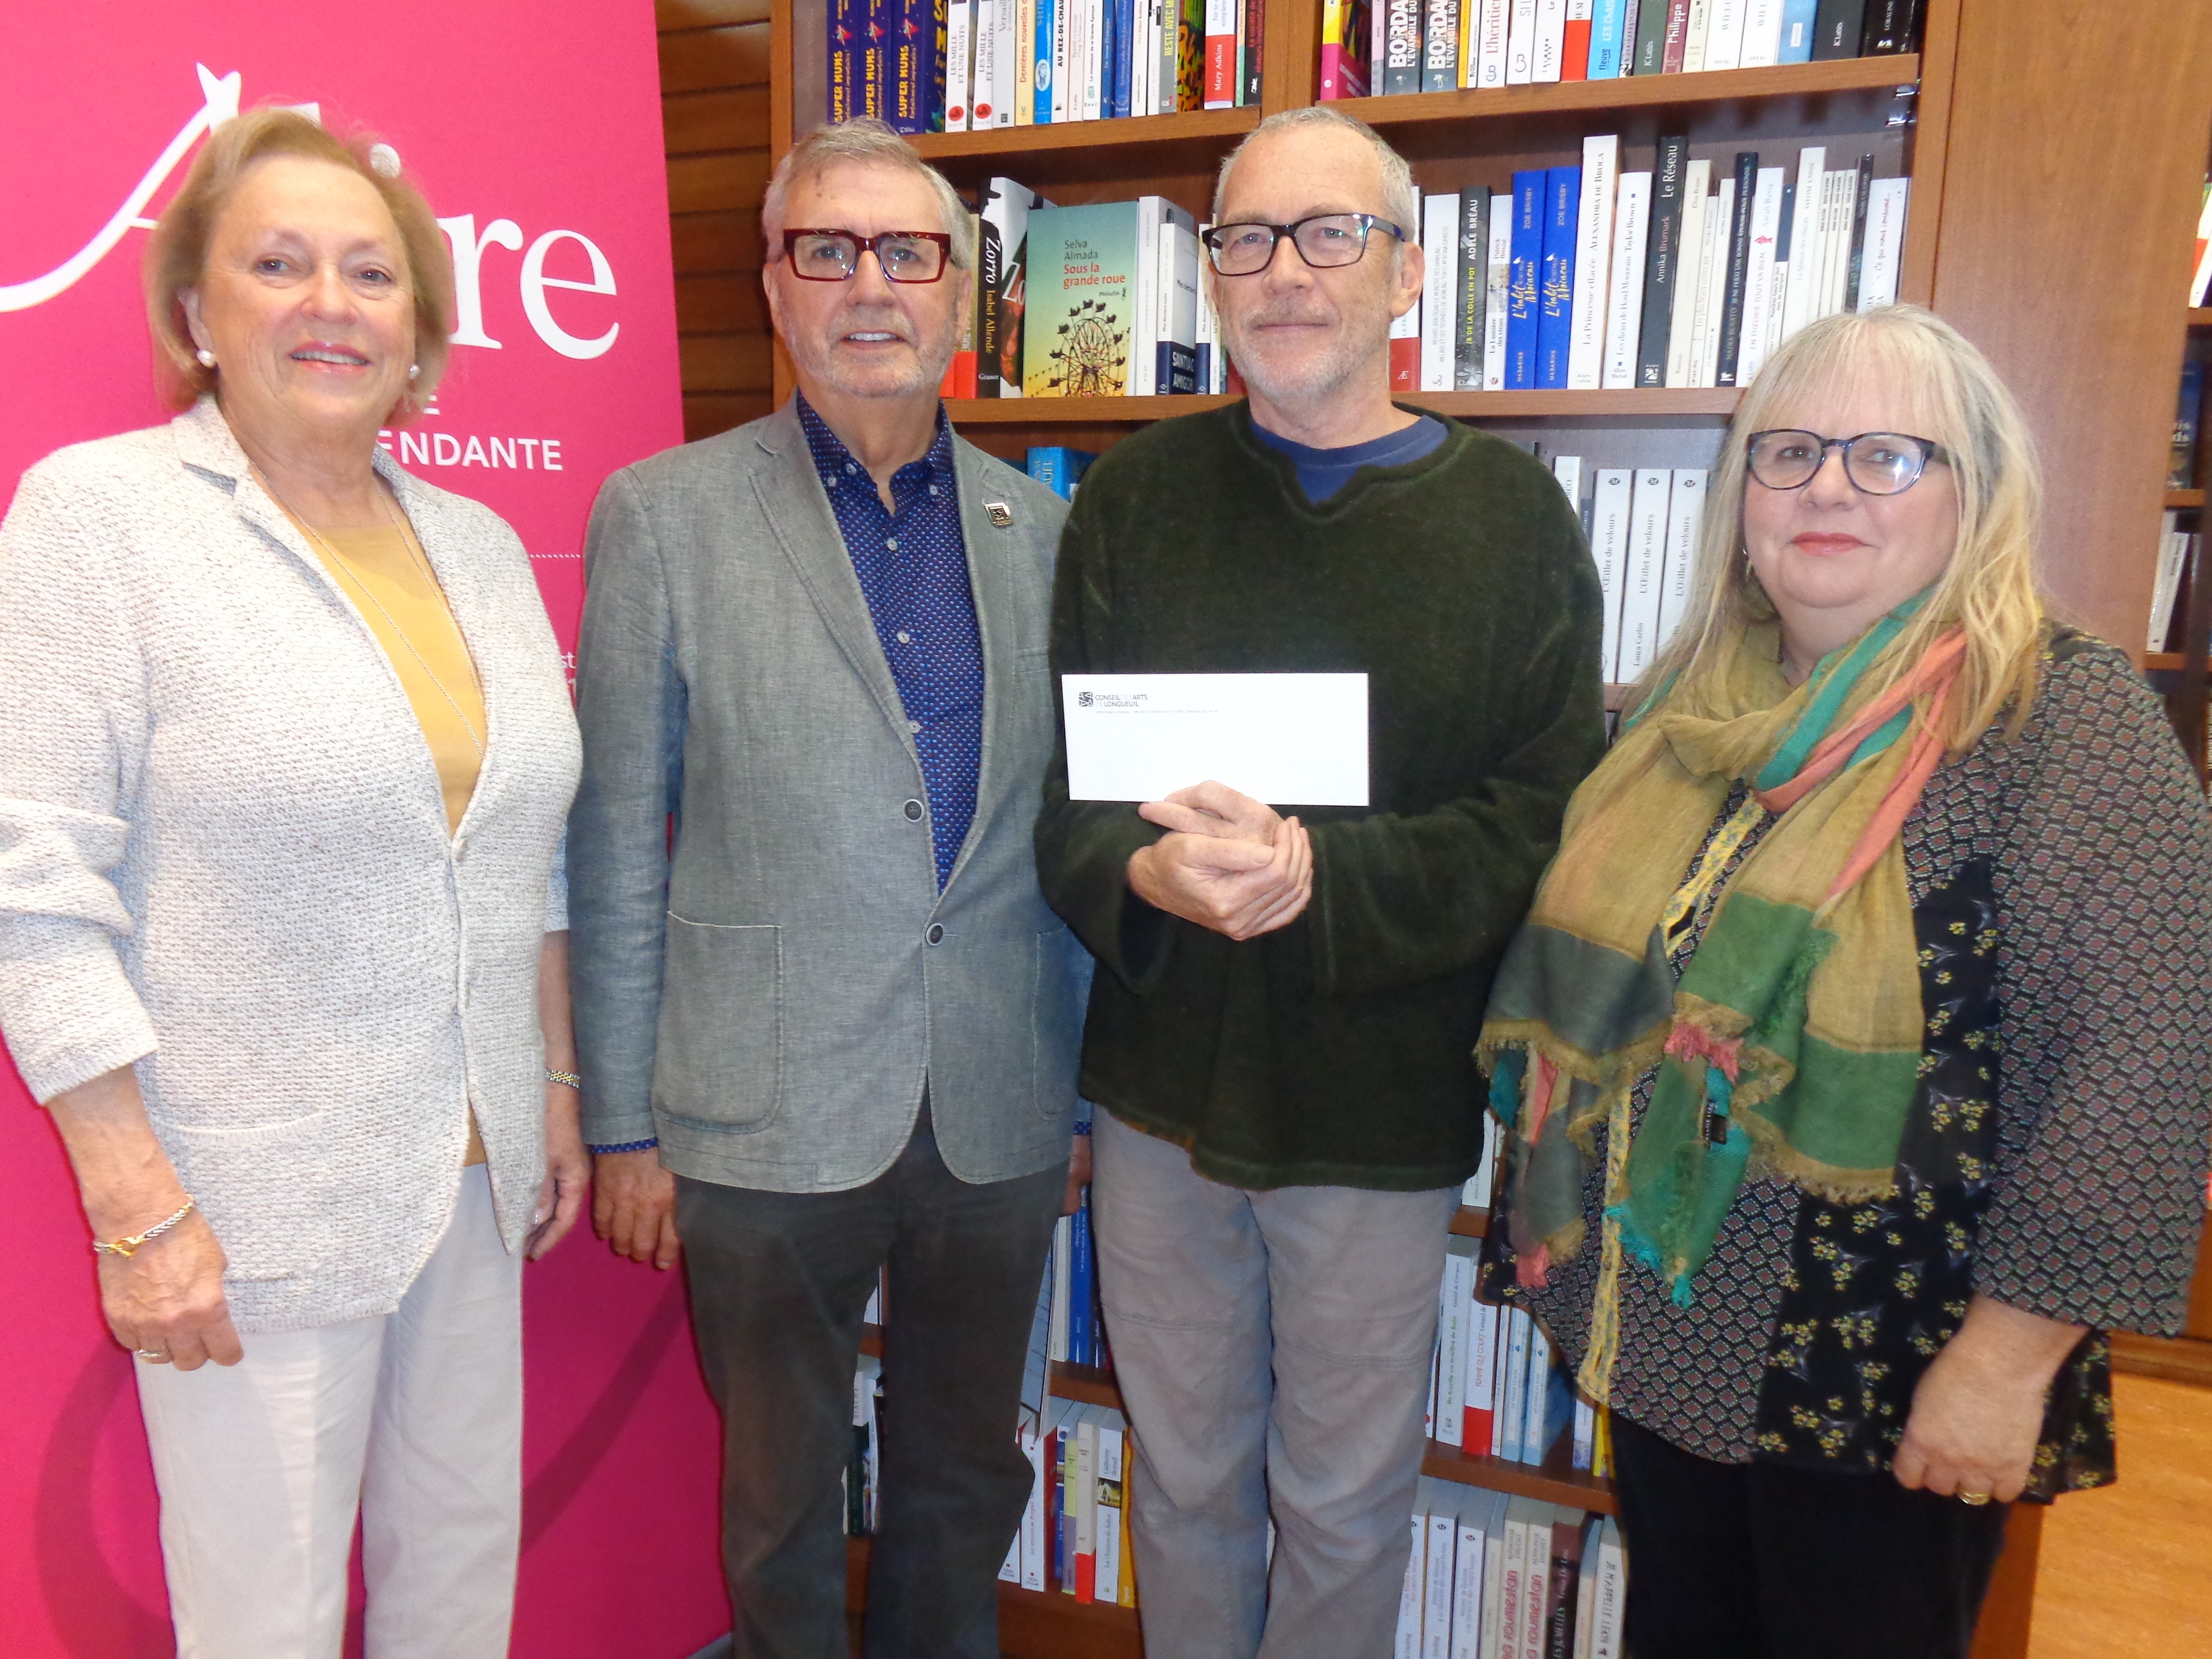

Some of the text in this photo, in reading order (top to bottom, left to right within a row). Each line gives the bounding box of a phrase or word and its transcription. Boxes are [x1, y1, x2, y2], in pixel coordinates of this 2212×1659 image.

[1447, 1, 1457, 15] DU
[1163, 9, 1175, 56] RESTE AVEC
[1667, 3, 1686, 44] Philippe
[1019, 45, 1027, 83] Dernières
[1058, 56, 1063, 67] AU
[1214, 43, 1223, 91] Mary Adkins
[1598, 48, 1606, 70] fleuve
[958, 73, 964, 84] ET
[986, 69, 992, 81] ET
[833, 85, 843, 122] SUPER
[899, 80, 909, 118] SUPER
[1525, 186, 1533, 213] BRISBY
[1558, 182, 1567, 209] BRISBY
[1468, 199, 1479, 228] BRÉAU
[1656, 144, 1679, 284] Annika Le Réseau
[1064, 239, 1087, 249] Selva
[1492, 238, 1501, 258] Patrick
[1582, 152, 1605, 345] La Princesse effacée ALEXANDRA DE BROCA
[1874, 230, 1887, 271] Ce qui nous
[1063, 250, 1098, 261] Almada
[1757, 252, 1766, 270] BIEN
[1063, 262, 1099, 275] Sous la
[1468, 266, 1476, 279] POT
[1756, 271, 1764, 281] VA
[1063, 274, 1126, 290] grande roue
[1468, 282, 1476, 290] EN
[1615, 203, 1636, 356] Les dieux de Howl Mountain Taylor Brown
[985, 236, 1001, 354] Zorro Isabel Allende
[1696, 286, 1707, 303] beaux
[1753, 283, 1763, 303] TOUT
[1467, 293, 1475, 314] COLLE
[1695, 303, 1707, 316] plus
[1467, 325, 1474, 335] DE
[1489, 345, 1495, 353] La
[1749, 337, 1756, 349] EN
[1605, 513, 1615, 545] velours
[1644, 514, 1655, 545] velours
[1680, 516, 1691, 548] velours
[1604, 547, 1612, 557] de
[1642, 547, 1651, 558] de
[1678, 550, 1688, 561] de
[1633, 623, 1644, 666] Laura Carlin
[1448, 1341, 1456, 1363] maillot
[1476, 1355, 1485, 1366] QUI
[1449, 1365, 1455, 1373] en
[1446, 1374, 1454, 1395] Gaulle
[1446, 1396, 1452, 1405] De
[1601, 1561, 1616, 1618] JE M'APPELLE
[1503, 1570, 1518, 1640] roumestan
[1527, 1574, 1543, 1645] roumestan
